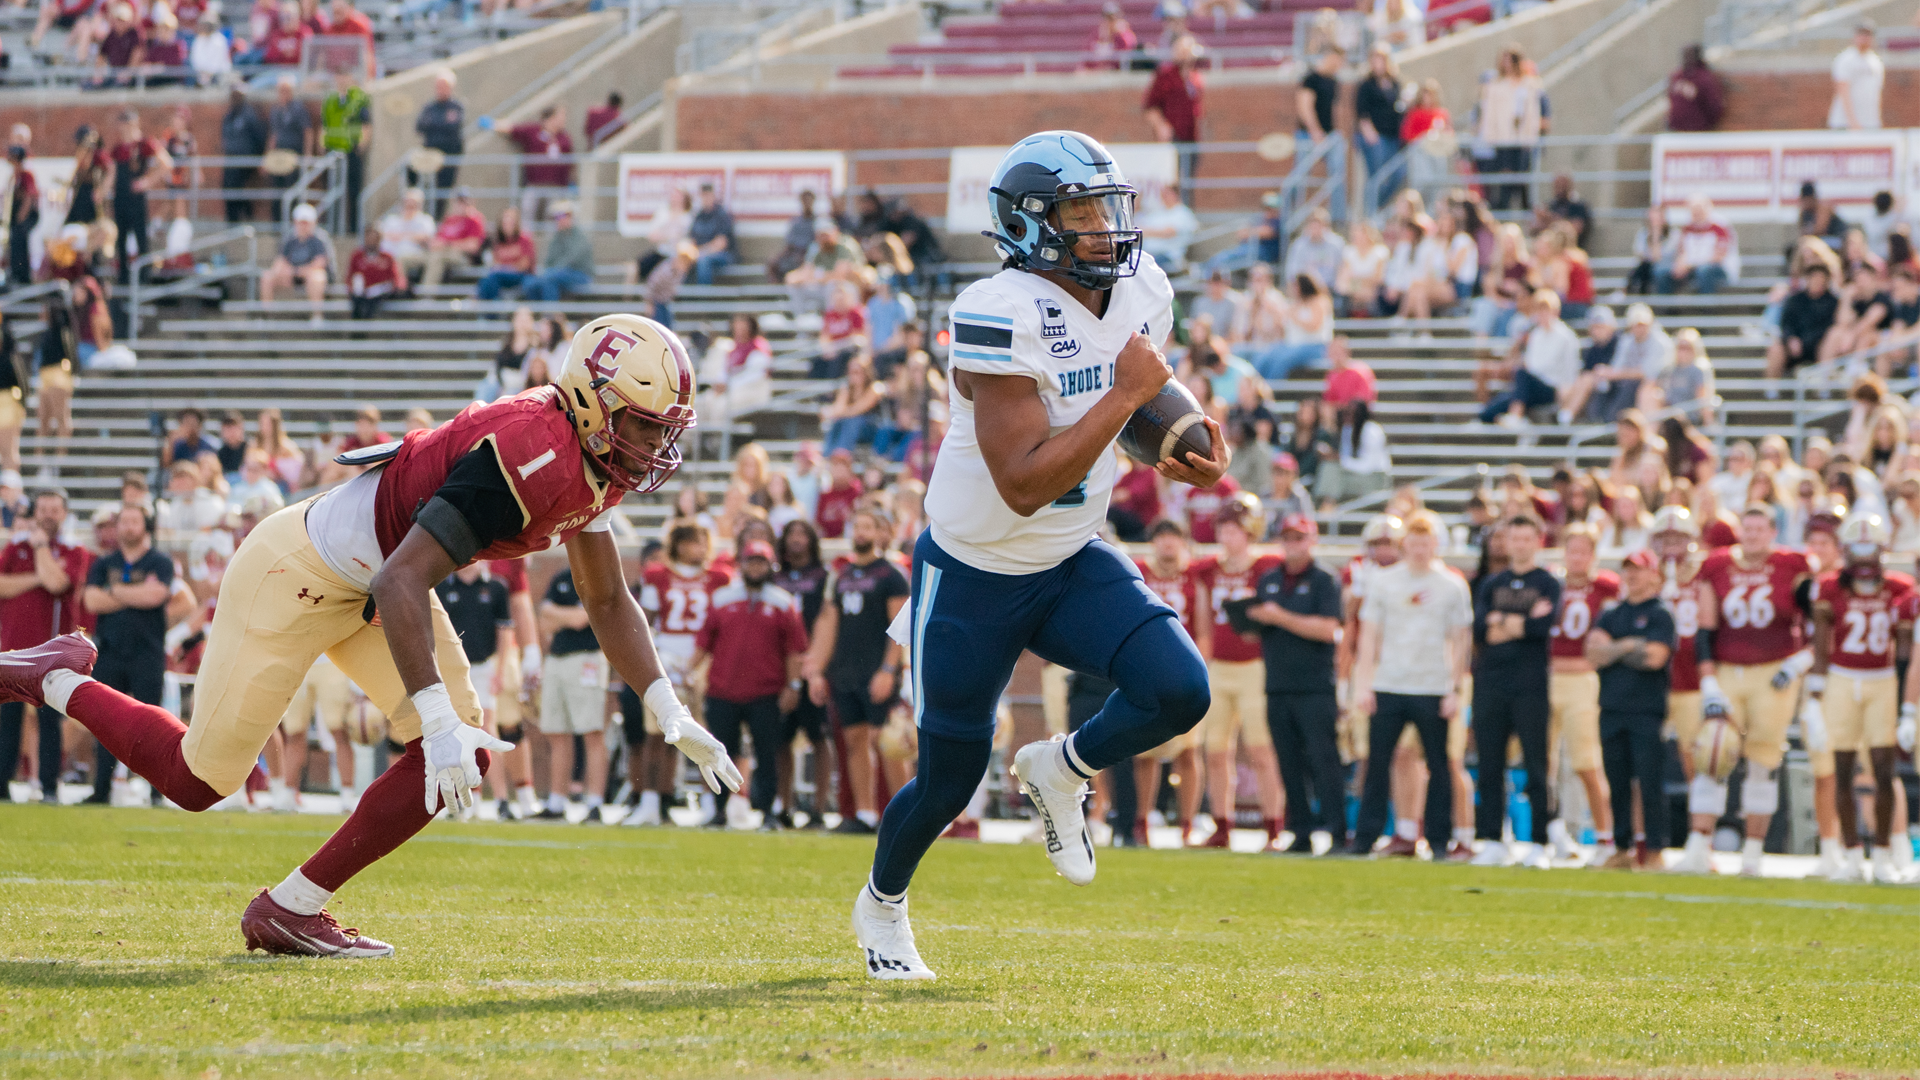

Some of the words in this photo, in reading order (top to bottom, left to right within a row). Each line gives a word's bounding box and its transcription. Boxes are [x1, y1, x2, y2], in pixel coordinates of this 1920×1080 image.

[581, 327, 641, 382] E
[1050, 338, 1077, 354] CAA
[1057, 364, 1102, 398] RHODE
[516, 448, 557, 481] 1
[665, 588, 709, 631] 23
[1723, 585, 1776, 629] 66
[1842, 610, 1890, 655] 28
